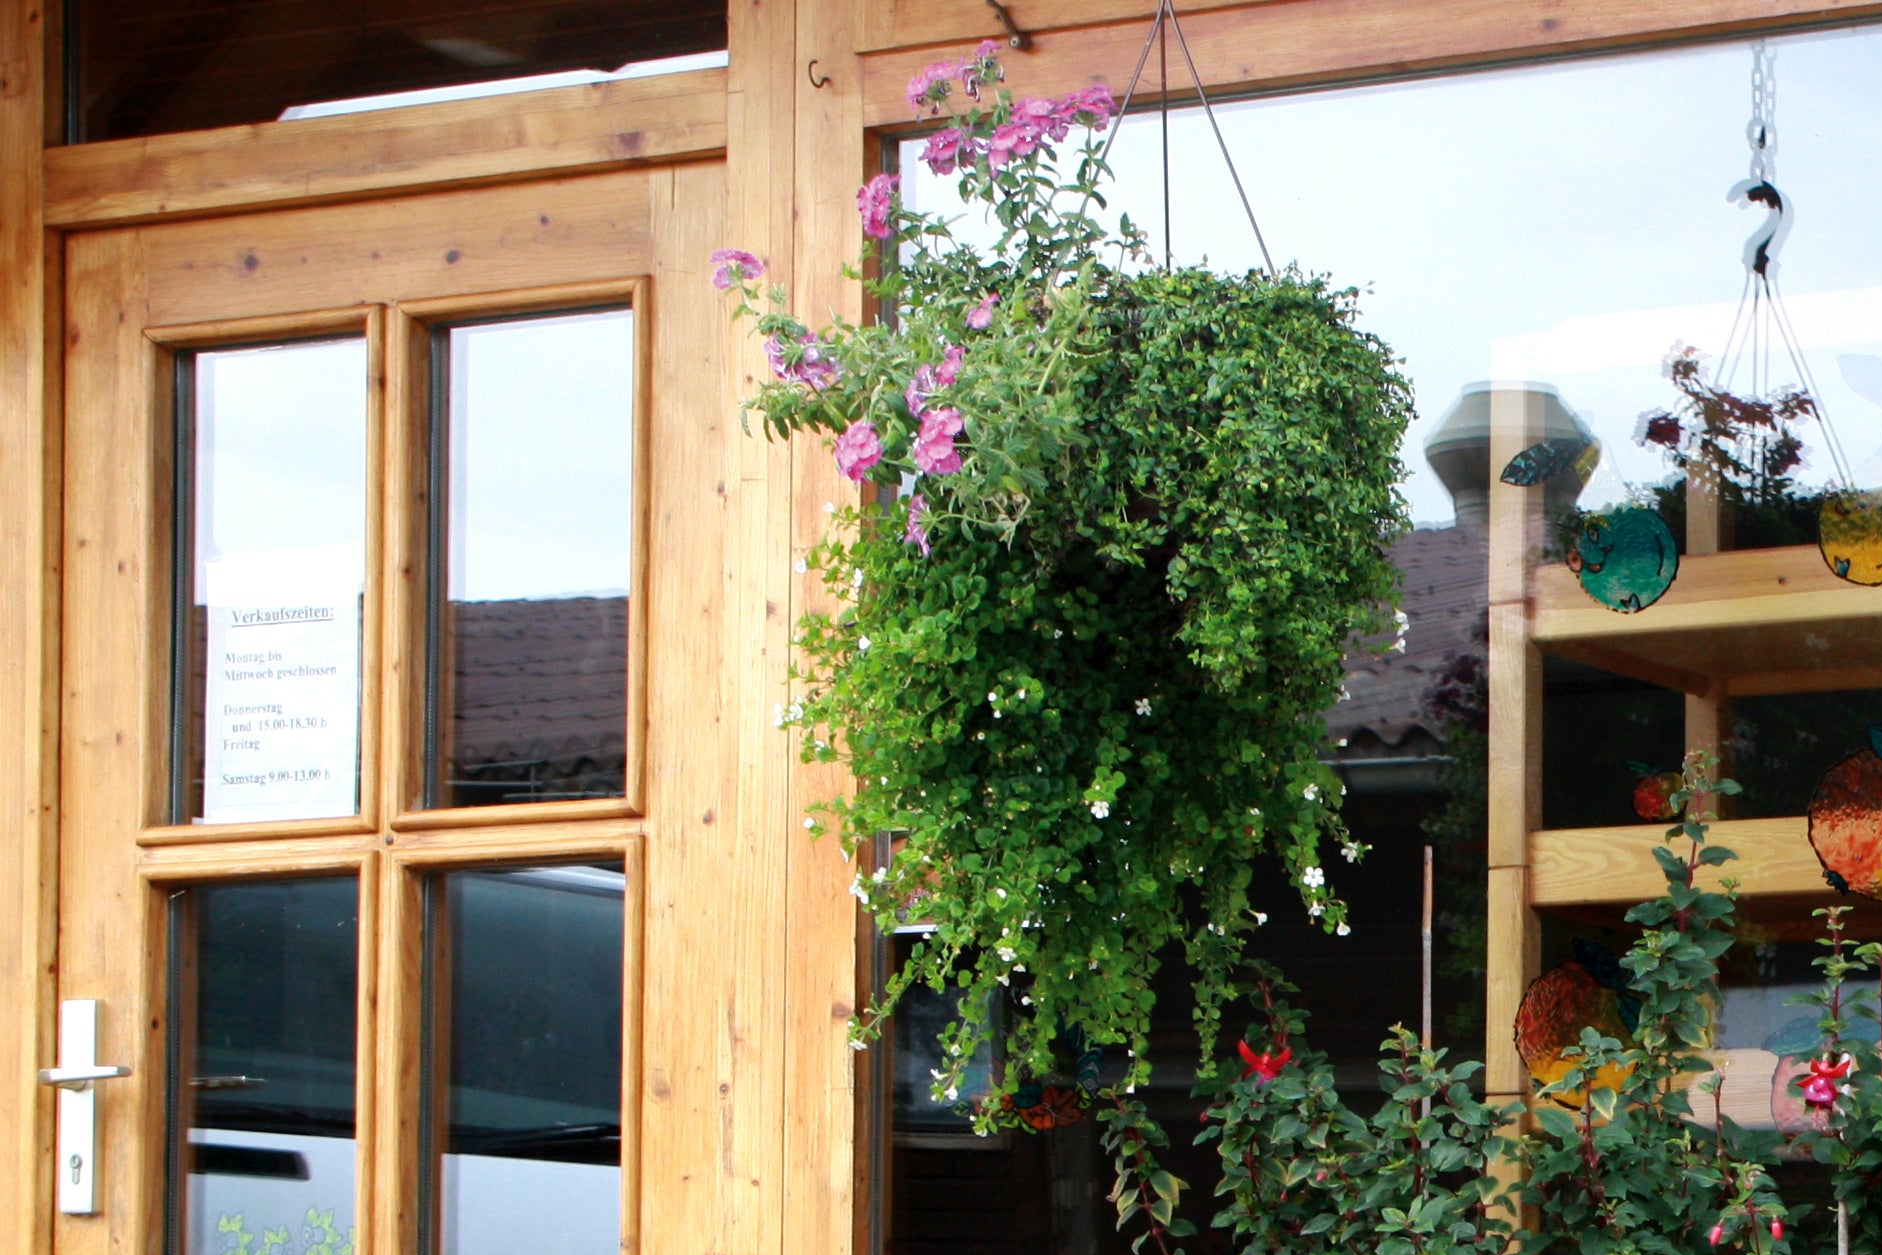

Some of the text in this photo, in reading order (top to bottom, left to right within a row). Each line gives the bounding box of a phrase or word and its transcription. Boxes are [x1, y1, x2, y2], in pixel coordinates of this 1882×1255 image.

[232, 606, 334, 624] Verkaufszeiten:
[225, 650, 283, 665] Montag bis
[224, 665, 337, 681] Mittwoch geschlossen
[223, 704, 283, 716] Donnerstag
[232, 721, 252, 733] und
[223, 739, 260, 752] Freitag
[221, 773, 266, 786] Samstag
[268, 769, 322, 783] 9.00-13.00
